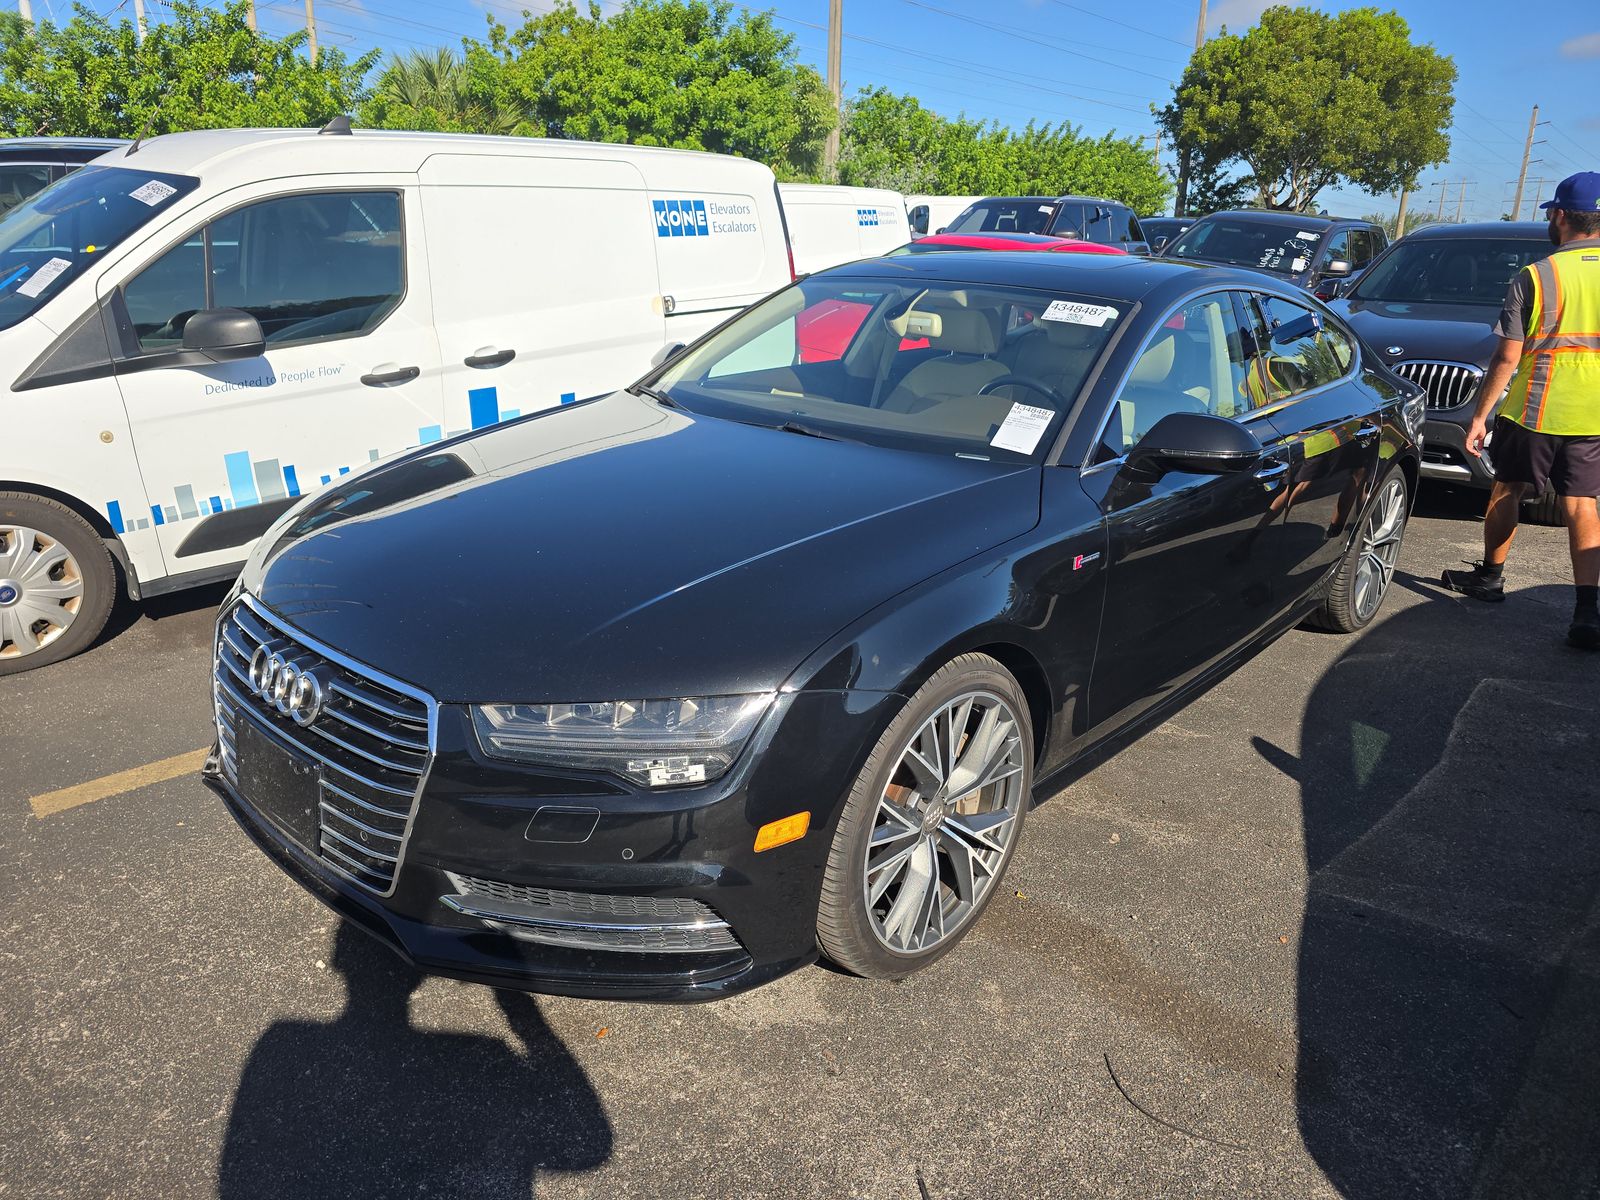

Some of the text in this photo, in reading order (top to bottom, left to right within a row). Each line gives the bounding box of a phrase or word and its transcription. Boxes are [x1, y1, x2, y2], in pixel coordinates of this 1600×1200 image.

[655, 203, 751, 227] KONE Elevators
[712, 221, 757, 233] Escalators
[1051, 303, 1107, 317] 4348487
[204, 376, 262, 396] Dedicated
[265, 376, 277, 385] to
[280, 368, 316, 384] People
